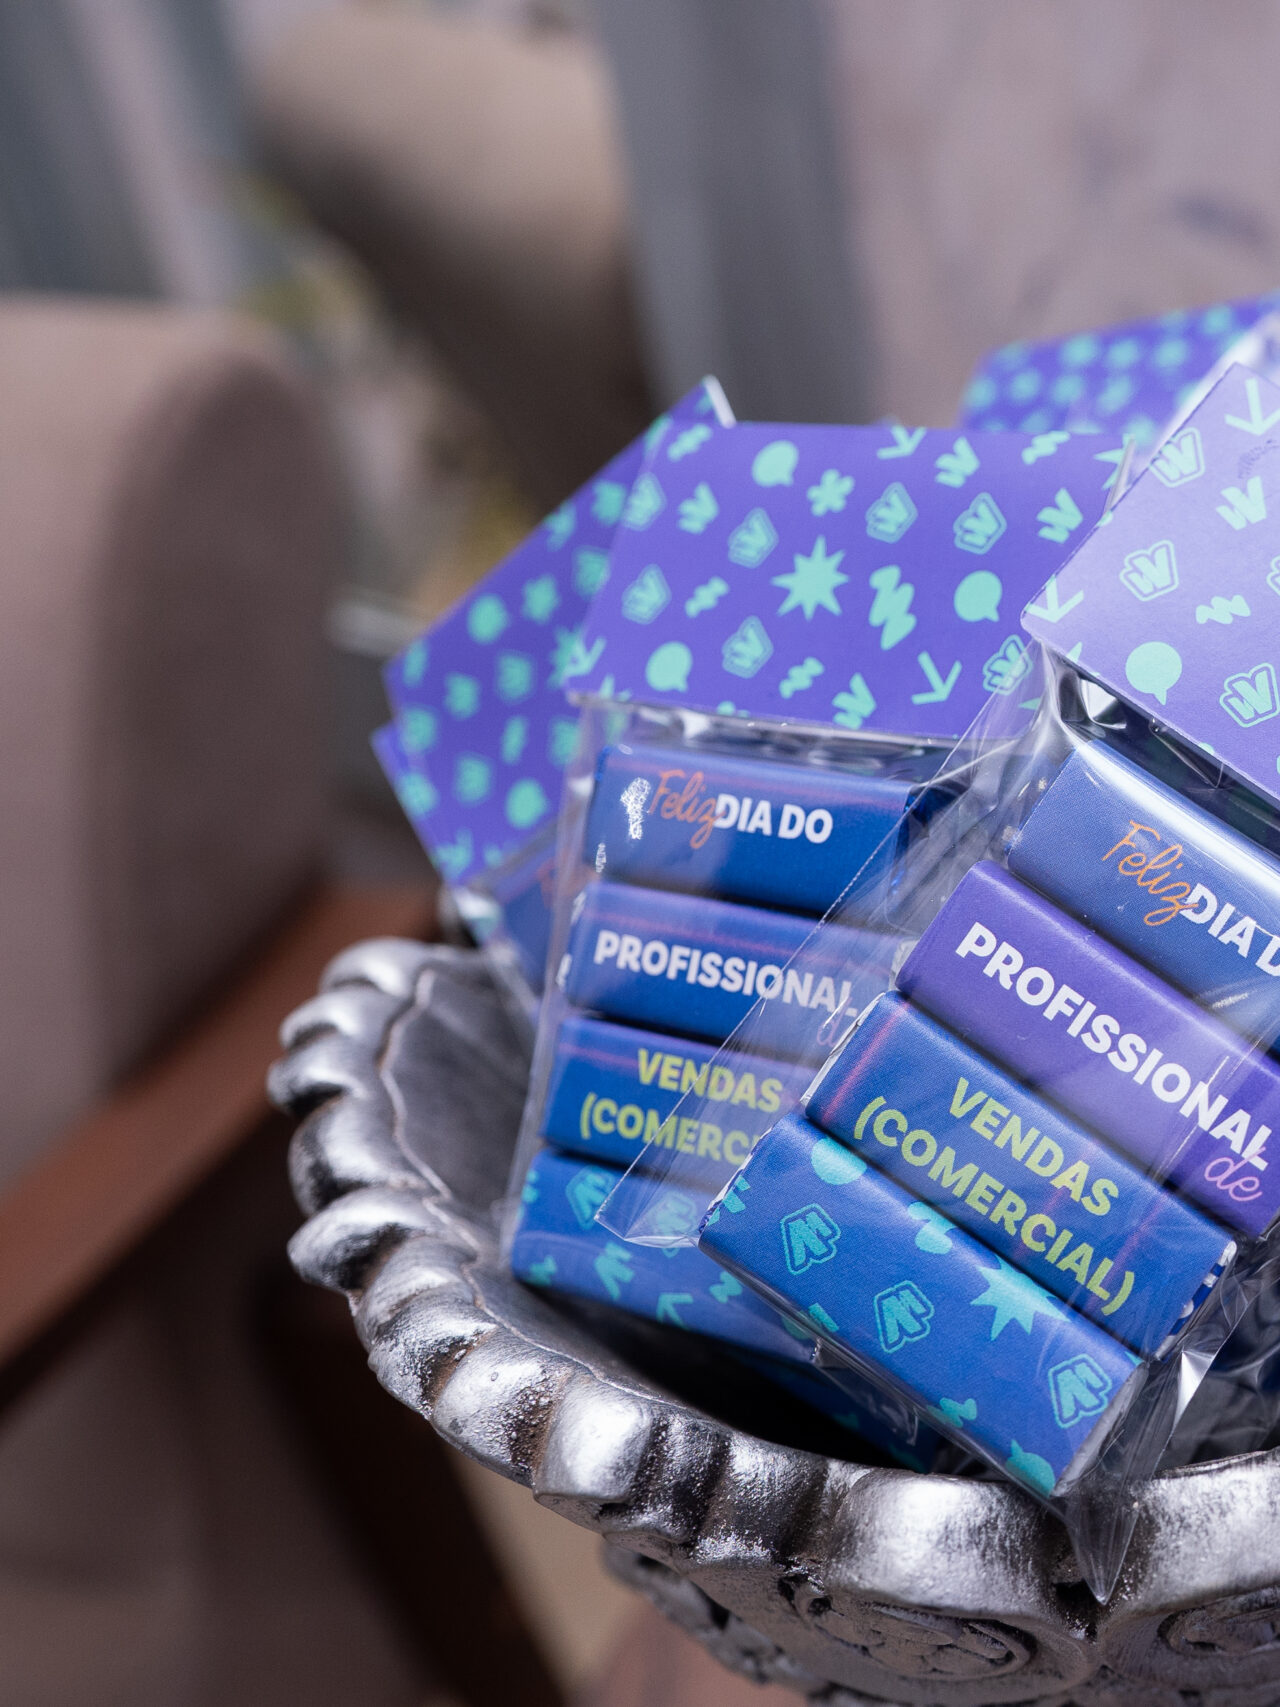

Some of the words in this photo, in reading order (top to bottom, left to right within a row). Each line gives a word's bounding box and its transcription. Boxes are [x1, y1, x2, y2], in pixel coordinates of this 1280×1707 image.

[650, 769, 727, 849] Feliz
[713, 793, 772, 836] DIA
[778, 803, 833, 844] DO
[1102, 820, 1199, 926] Feliz
[1179, 883, 1257, 958] DIA
[594, 930, 859, 1018] PROFISSIONAL
[638, 1048, 783, 1113] VENDAS
[956, 922, 1272, 1171] PROFISSIONAL
[949, 1078, 1119, 1216] VENDAS
[1204, 1145, 1263, 1202] de
[854, 1097, 1135, 1316] (COMERCIAL)
